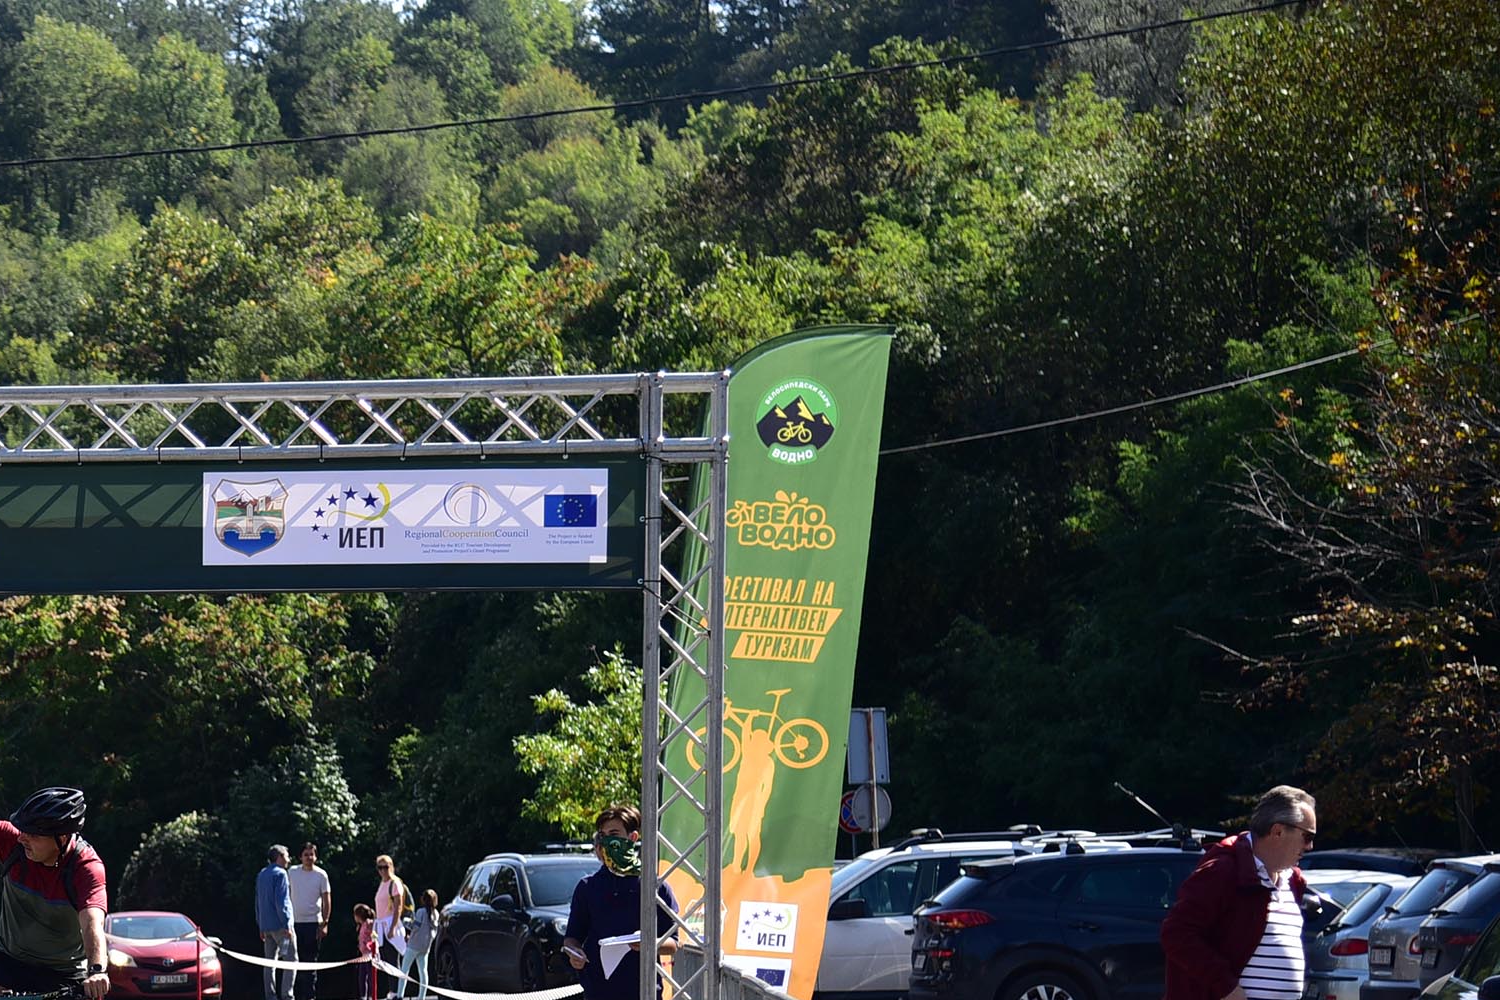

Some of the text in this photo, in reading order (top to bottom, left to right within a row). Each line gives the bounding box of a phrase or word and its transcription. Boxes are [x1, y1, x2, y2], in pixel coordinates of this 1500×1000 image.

[764, 381, 831, 408] ВЕЛОСИПЕДСКИ ПАРК
[771, 447, 814, 463] ВОДНО
[752, 504, 824, 527] ВЕЛО
[339, 527, 384, 548] ИЕП
[740, 524, 834, 548] ВОДНО
[811, 580, 835, 606] НА
[725, 603, 828, 632] ЛТЕРНАТИВЕН
[743, 634, 815, 660] ТУРИЗАМ
[757, 932, 786, 947] ИЕП
